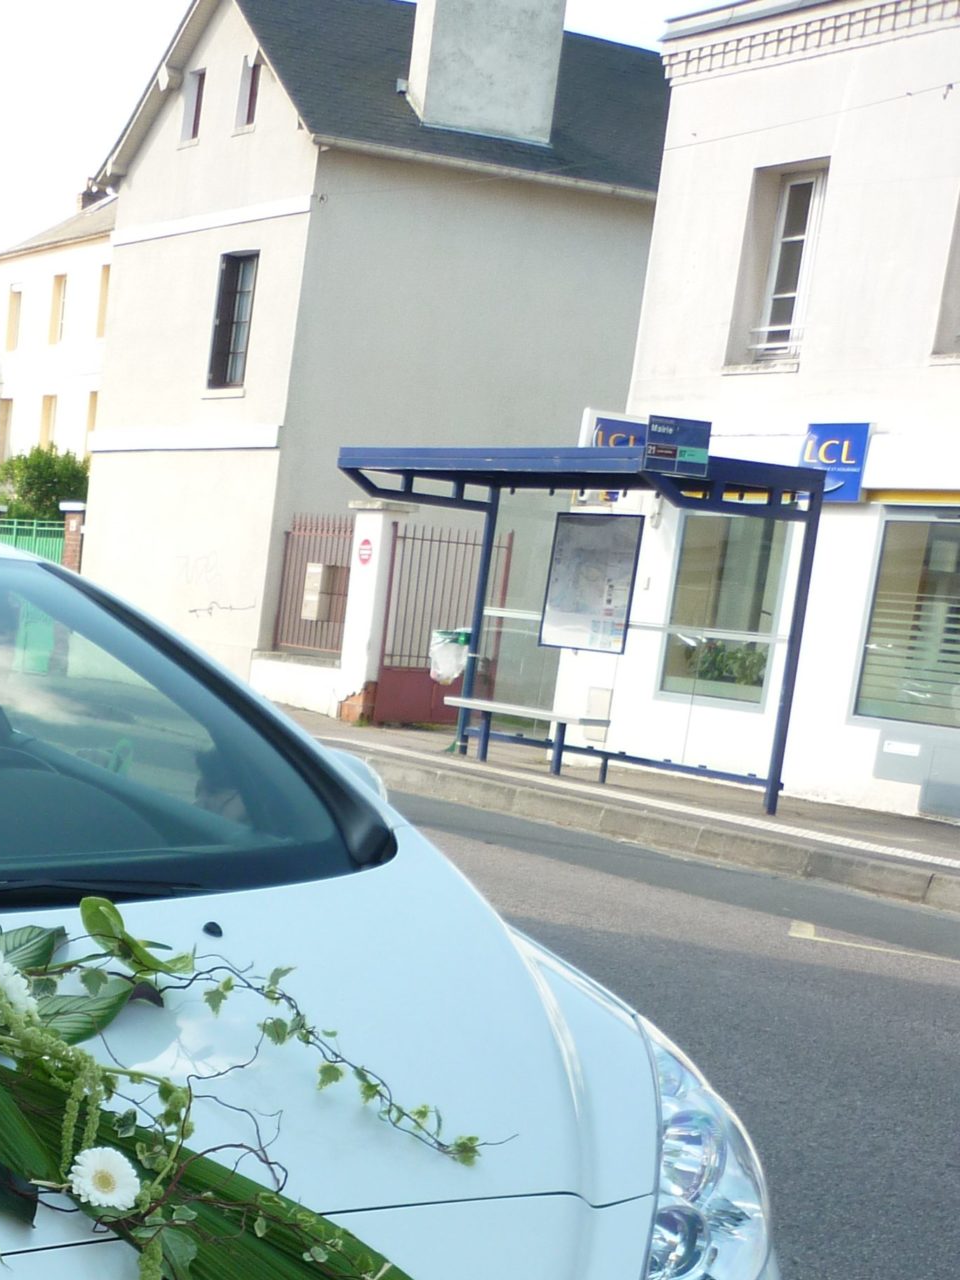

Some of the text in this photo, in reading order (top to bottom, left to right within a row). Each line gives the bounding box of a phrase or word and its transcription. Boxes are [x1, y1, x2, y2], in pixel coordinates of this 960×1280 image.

[651, 423, 674, 435] Mairie
[647, 445, 656, 455] 21
[803, 440, 856, 464] LCL
